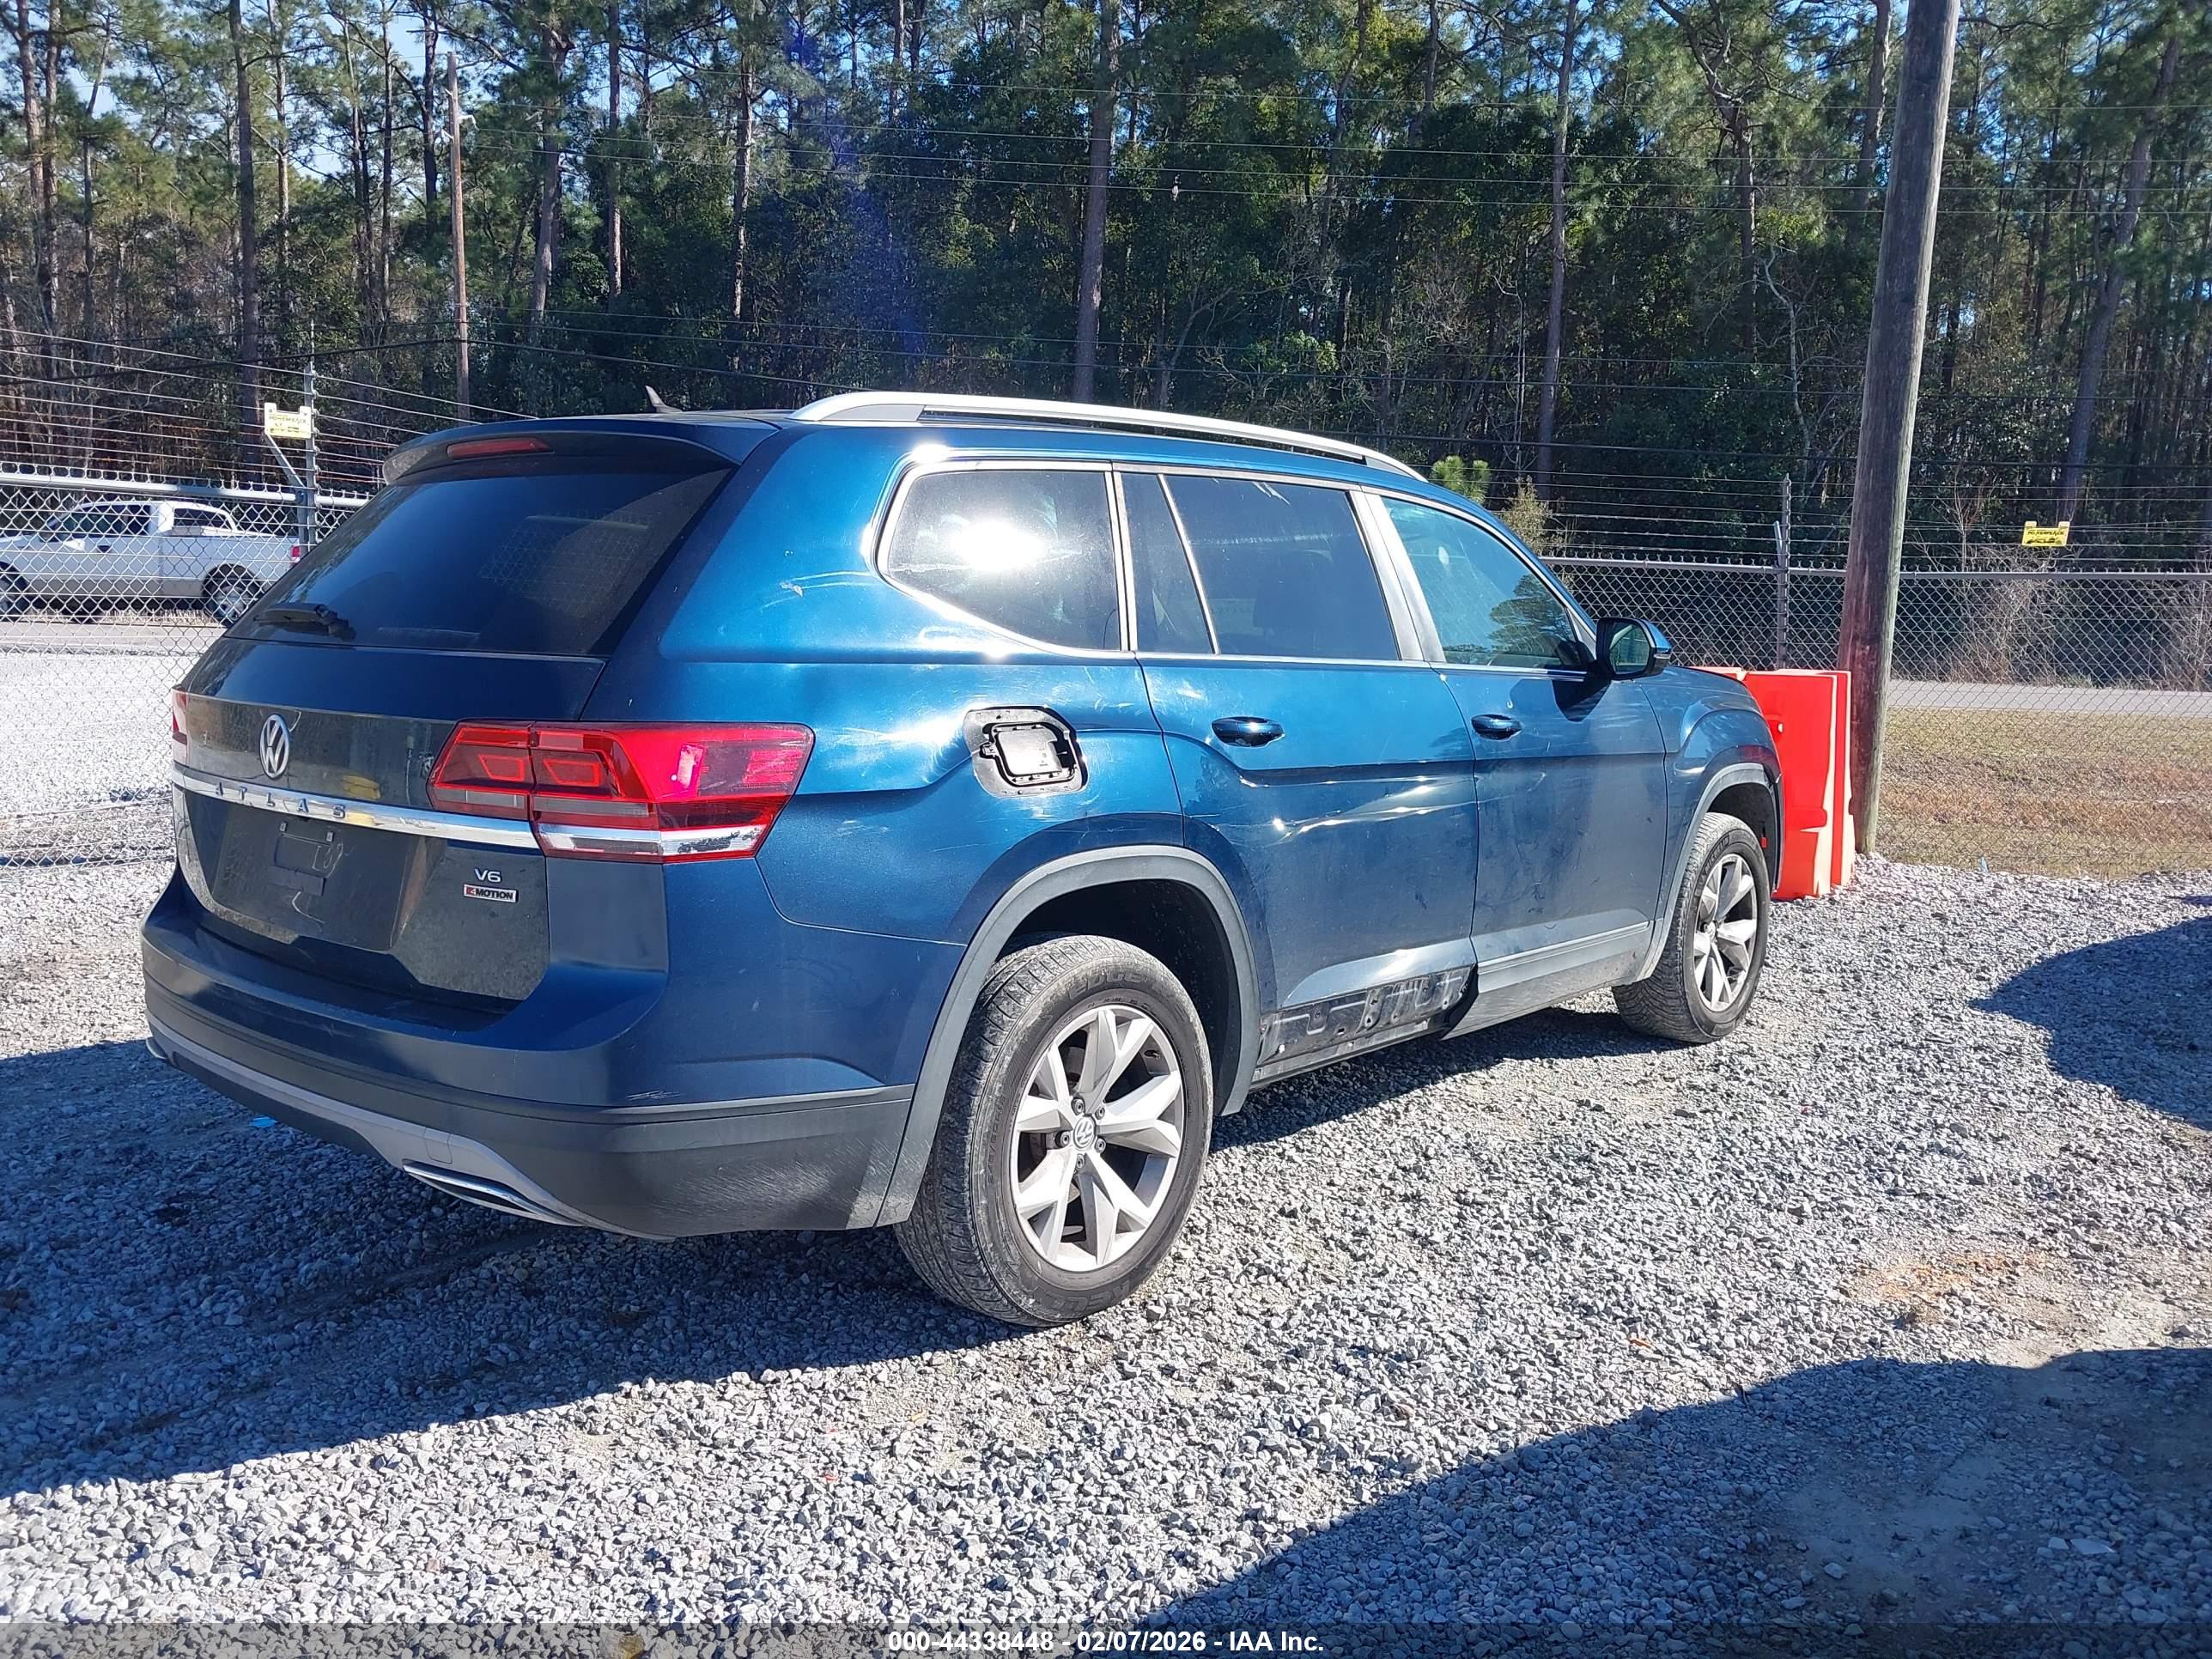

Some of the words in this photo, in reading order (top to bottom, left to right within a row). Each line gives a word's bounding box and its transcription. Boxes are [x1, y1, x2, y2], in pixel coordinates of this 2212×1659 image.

[216, 781, 346, 819] ATLAS
[474, 868, 501, 883] V6
[466, 886, 514, 900] 4MOTION
